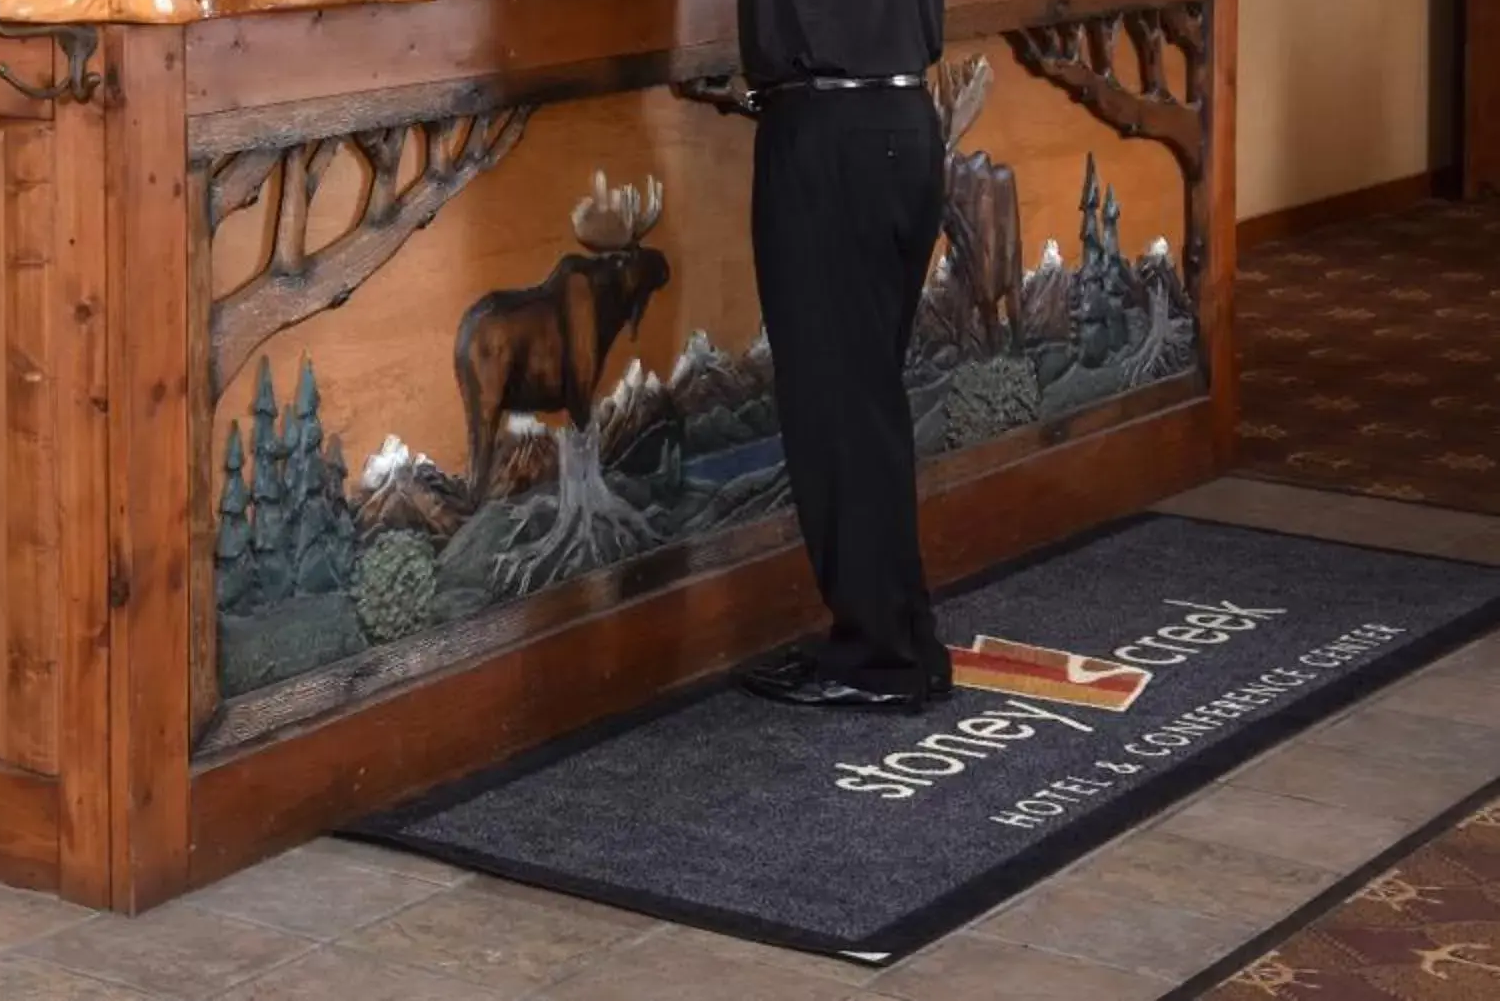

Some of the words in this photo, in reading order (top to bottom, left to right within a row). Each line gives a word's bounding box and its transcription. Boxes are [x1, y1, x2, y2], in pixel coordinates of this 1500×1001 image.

[835, 699, 1094, 799] stoney
[989, 775, 1111, 829] HOTEL
[1096, 759, 1142, 776] &
[1124, 666, 1317, 757] CONFERENCE
[1300, 621, 1408, 668] CENTER
